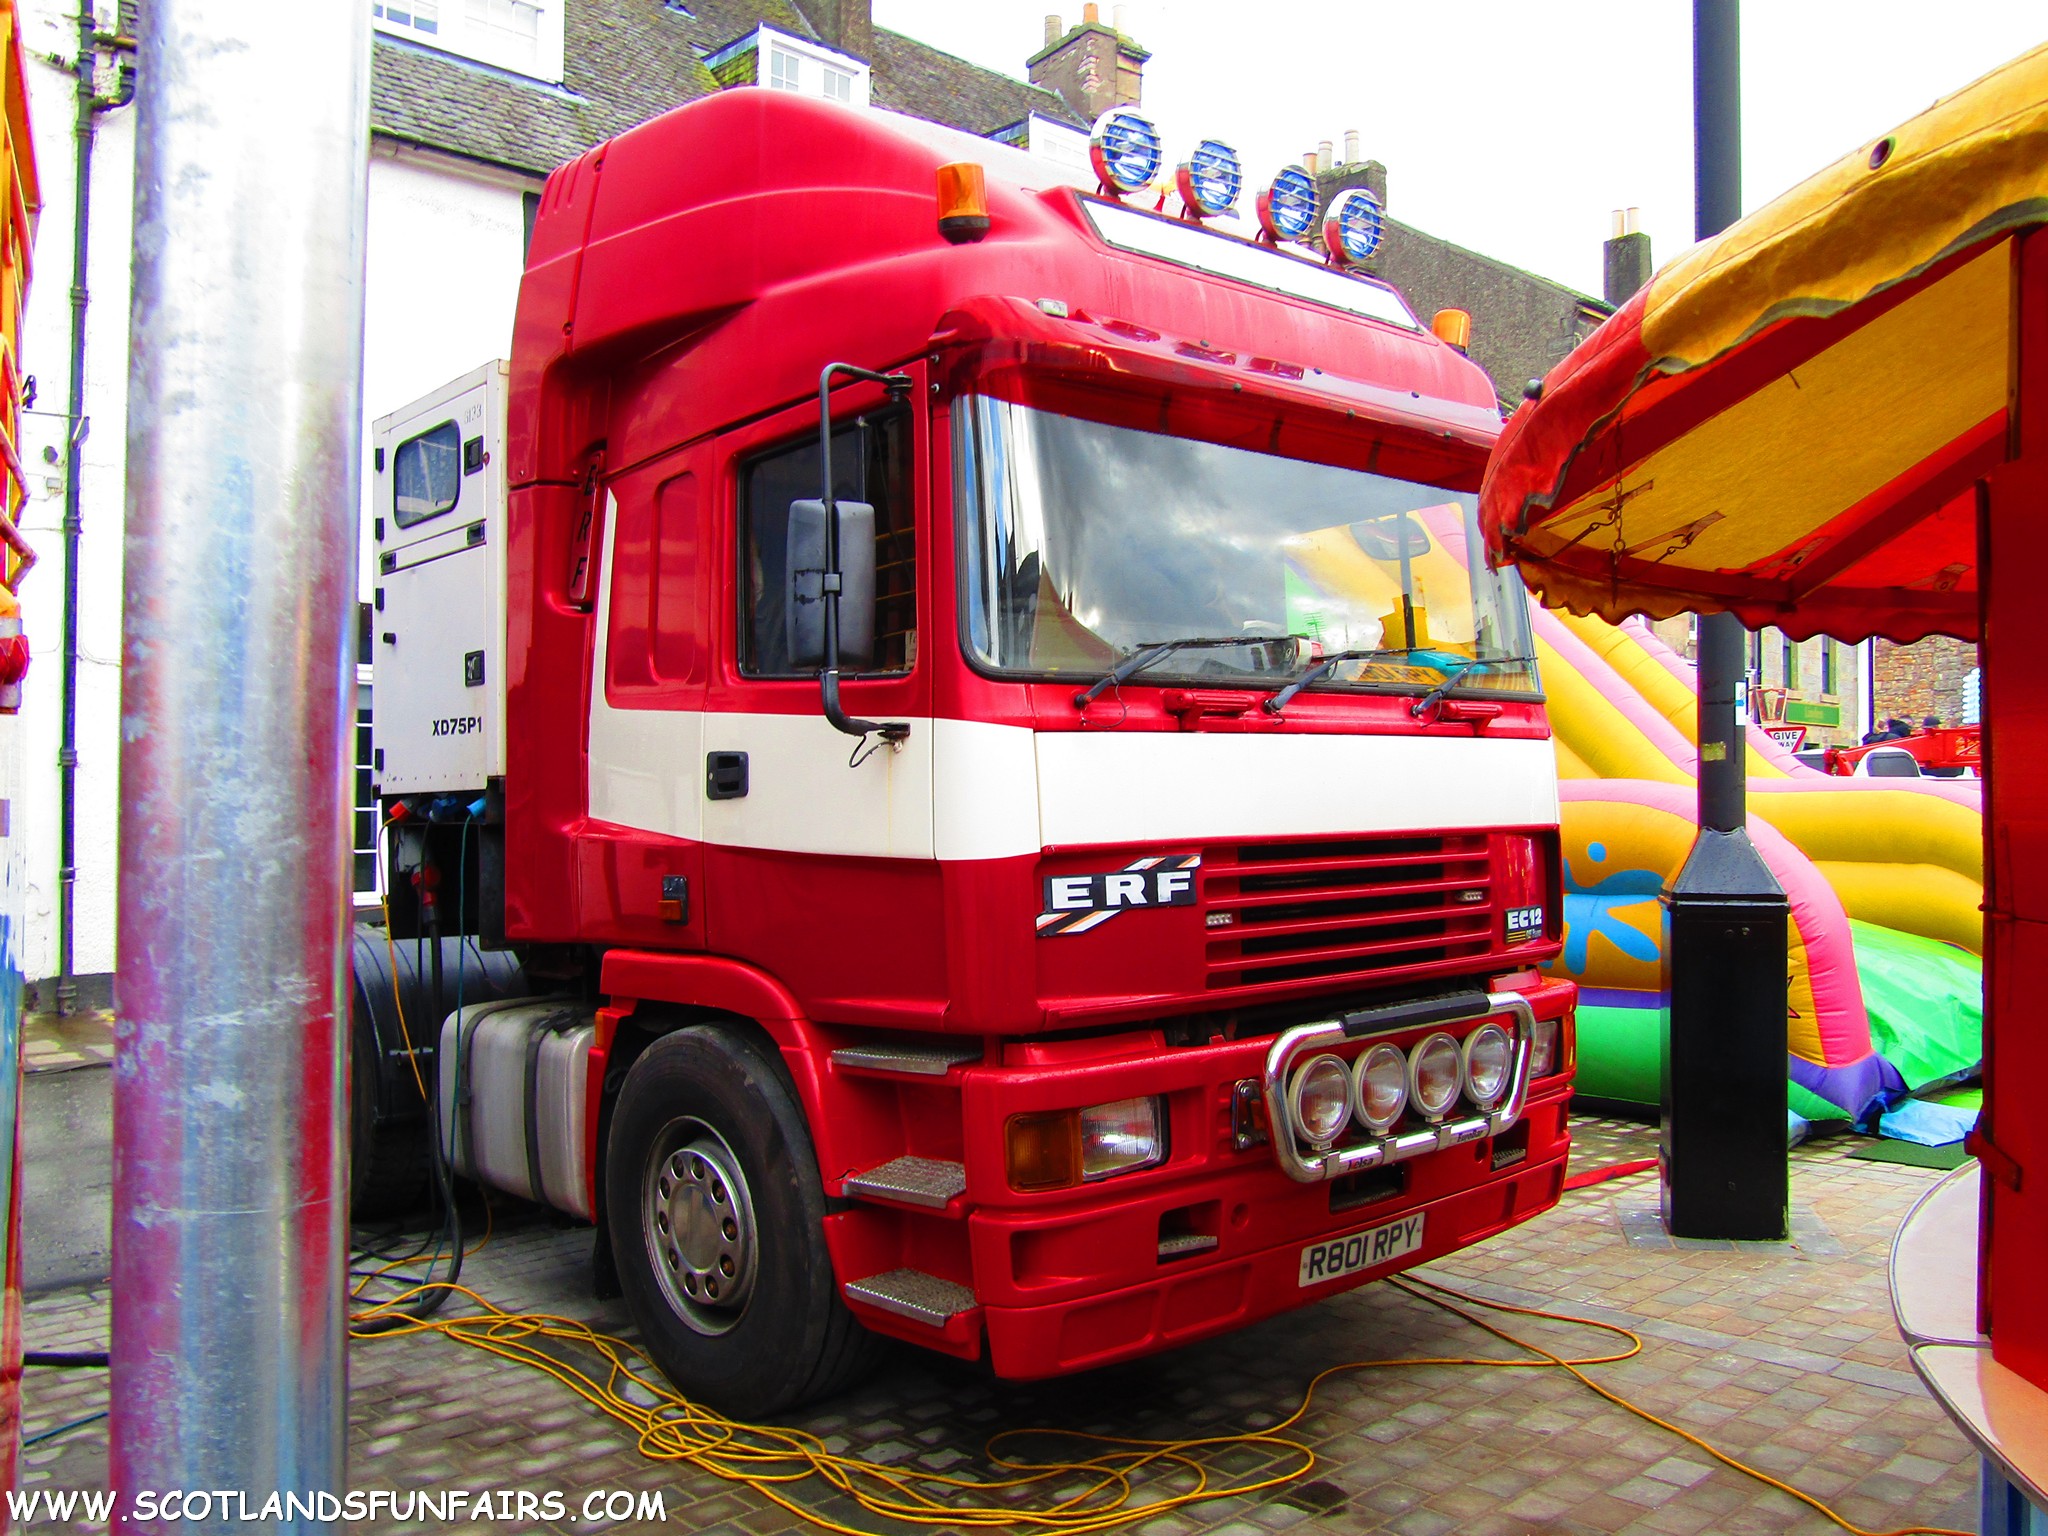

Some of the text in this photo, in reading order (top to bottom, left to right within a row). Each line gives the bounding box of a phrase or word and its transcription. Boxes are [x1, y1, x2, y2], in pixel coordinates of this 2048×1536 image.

[432, 716, 482, 736] XD75P1
[1773, 731, 1798, 740] GIVE
[1051, 870, 1192, 910] ERF
[1507, 907, 1542, 930] EC12
[1308, 1235, 1369, 1279] R801
[1373, 1217, 1417, 1260] RPY
